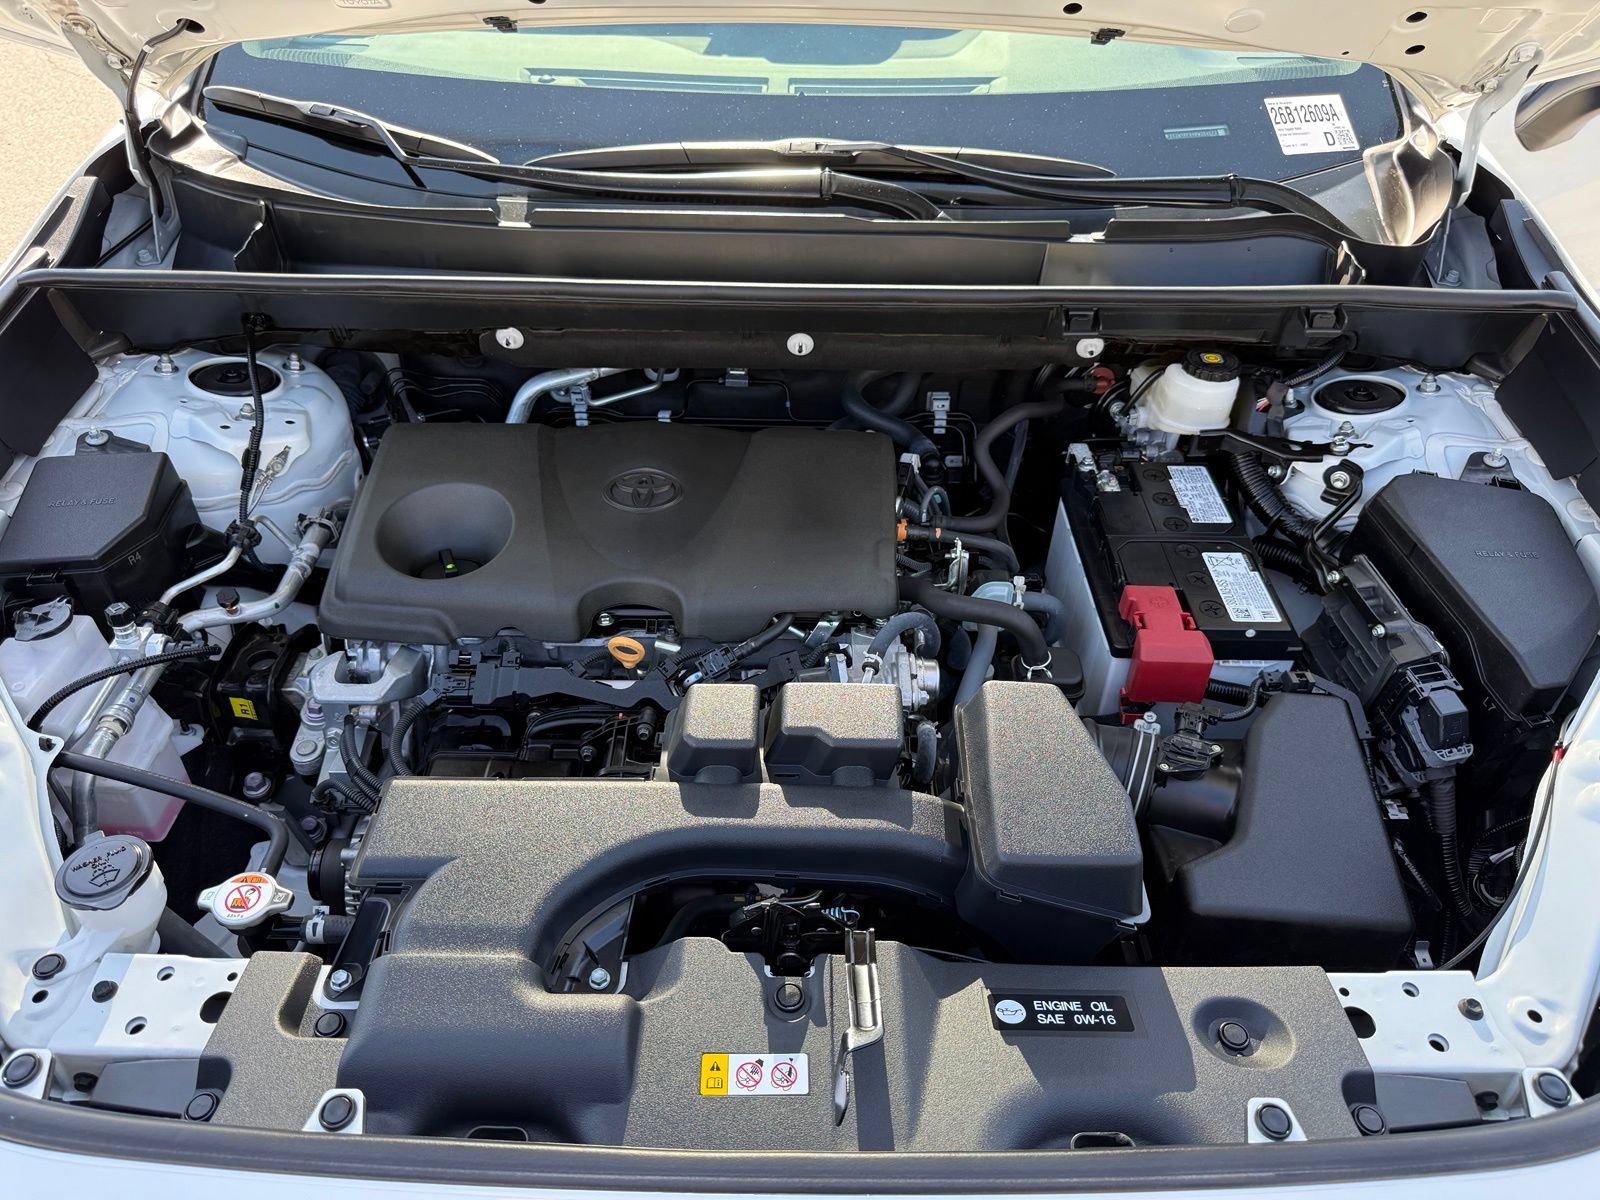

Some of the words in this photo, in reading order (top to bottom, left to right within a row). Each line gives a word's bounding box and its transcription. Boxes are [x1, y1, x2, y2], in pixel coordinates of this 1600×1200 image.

[1270, 103, 1340, 125] 26B12609A
[1323, 131, 1336, 146] D
[48, 499, 80, 508] RELAY
[90, 497, 117, 506] FUSE
[127, 551, 143, 566] R4
[1474, 550, 1504, 558] RELAY
[1514, 551, 1540, 559] FUSE
[71, 856, 103, 873] WASHER
[1033, 1000, 1083, 1012] ENGINE
[1090, 1001, 1114, 1012] OIL
[1036, 1013, 1066, 1025] SAE
[1073, 1014, 1117, 1025] 0W-16
